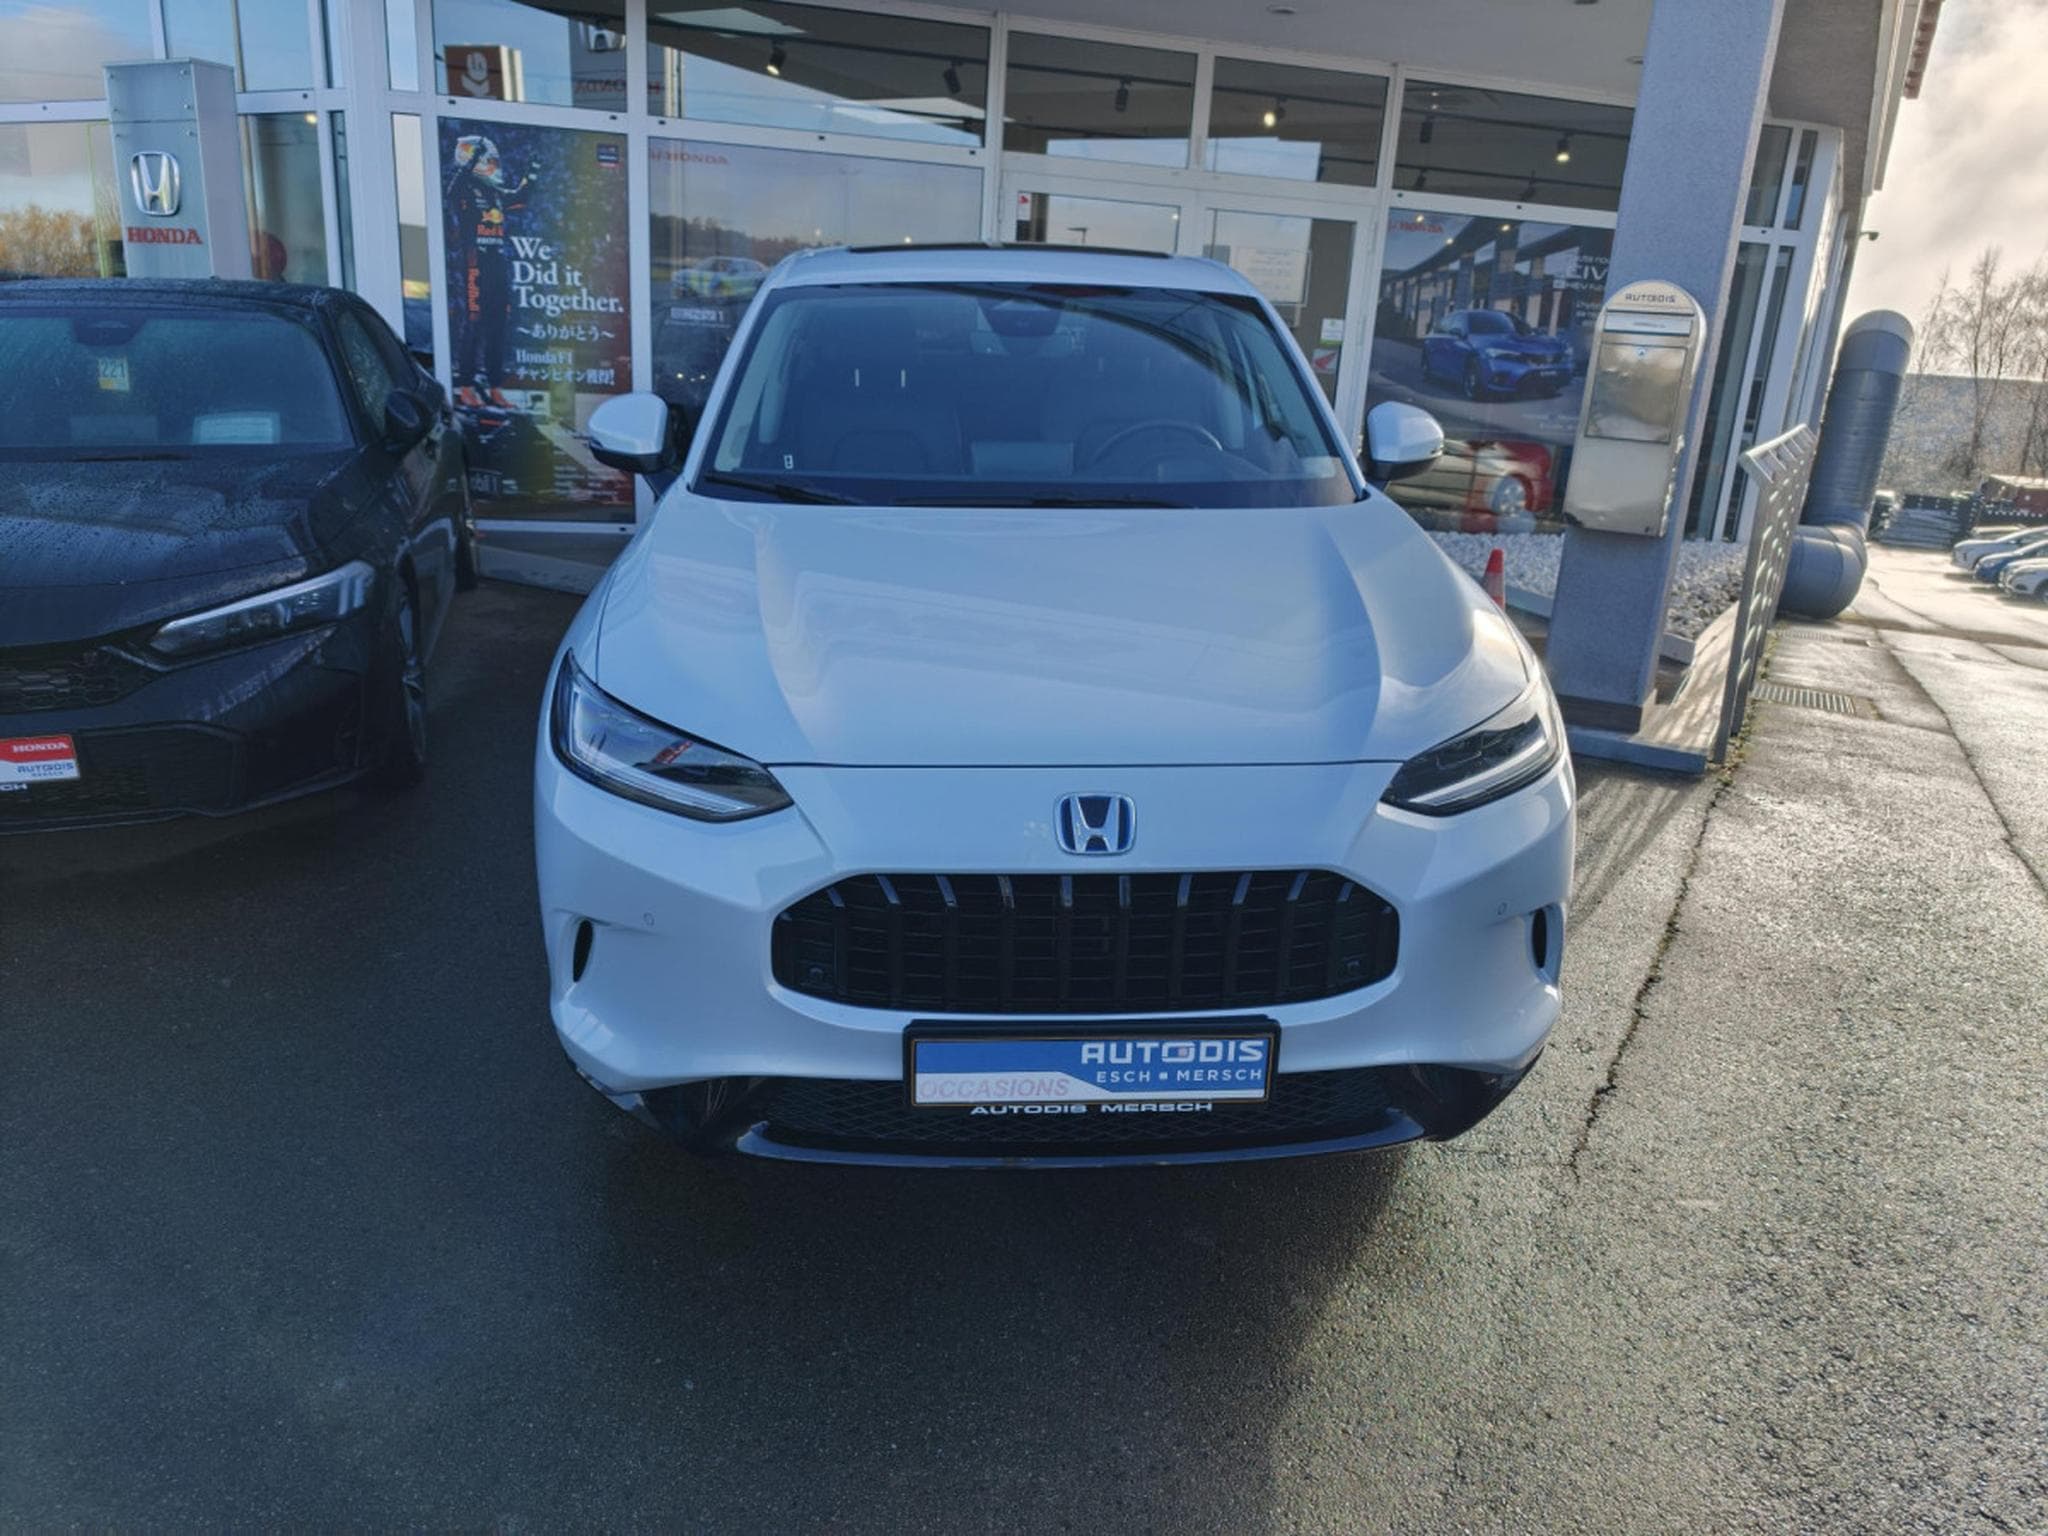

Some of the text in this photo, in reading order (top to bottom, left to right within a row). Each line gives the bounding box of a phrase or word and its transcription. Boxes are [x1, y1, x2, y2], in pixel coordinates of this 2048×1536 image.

[127, 226, 203, 245] HONDA
[511, 236, 551, 259] We
[513, 260, 583, 286] Did it
[513, 286, 624, 317] Together.
[516, 349, 556, 364] Honda
[12, 742, 69, 753] HONDA
[17, 762, 74, 773] AUTODIS
[1081, 1041, 1264, 1065] AUTODIS
[1096, 1069, 1262, 1083] ESCH MERSCH
[918, 1077, 1070, 1099] OCCASIONS
[970, 1102, 1213, 1116] AUTODIS MERSCH
